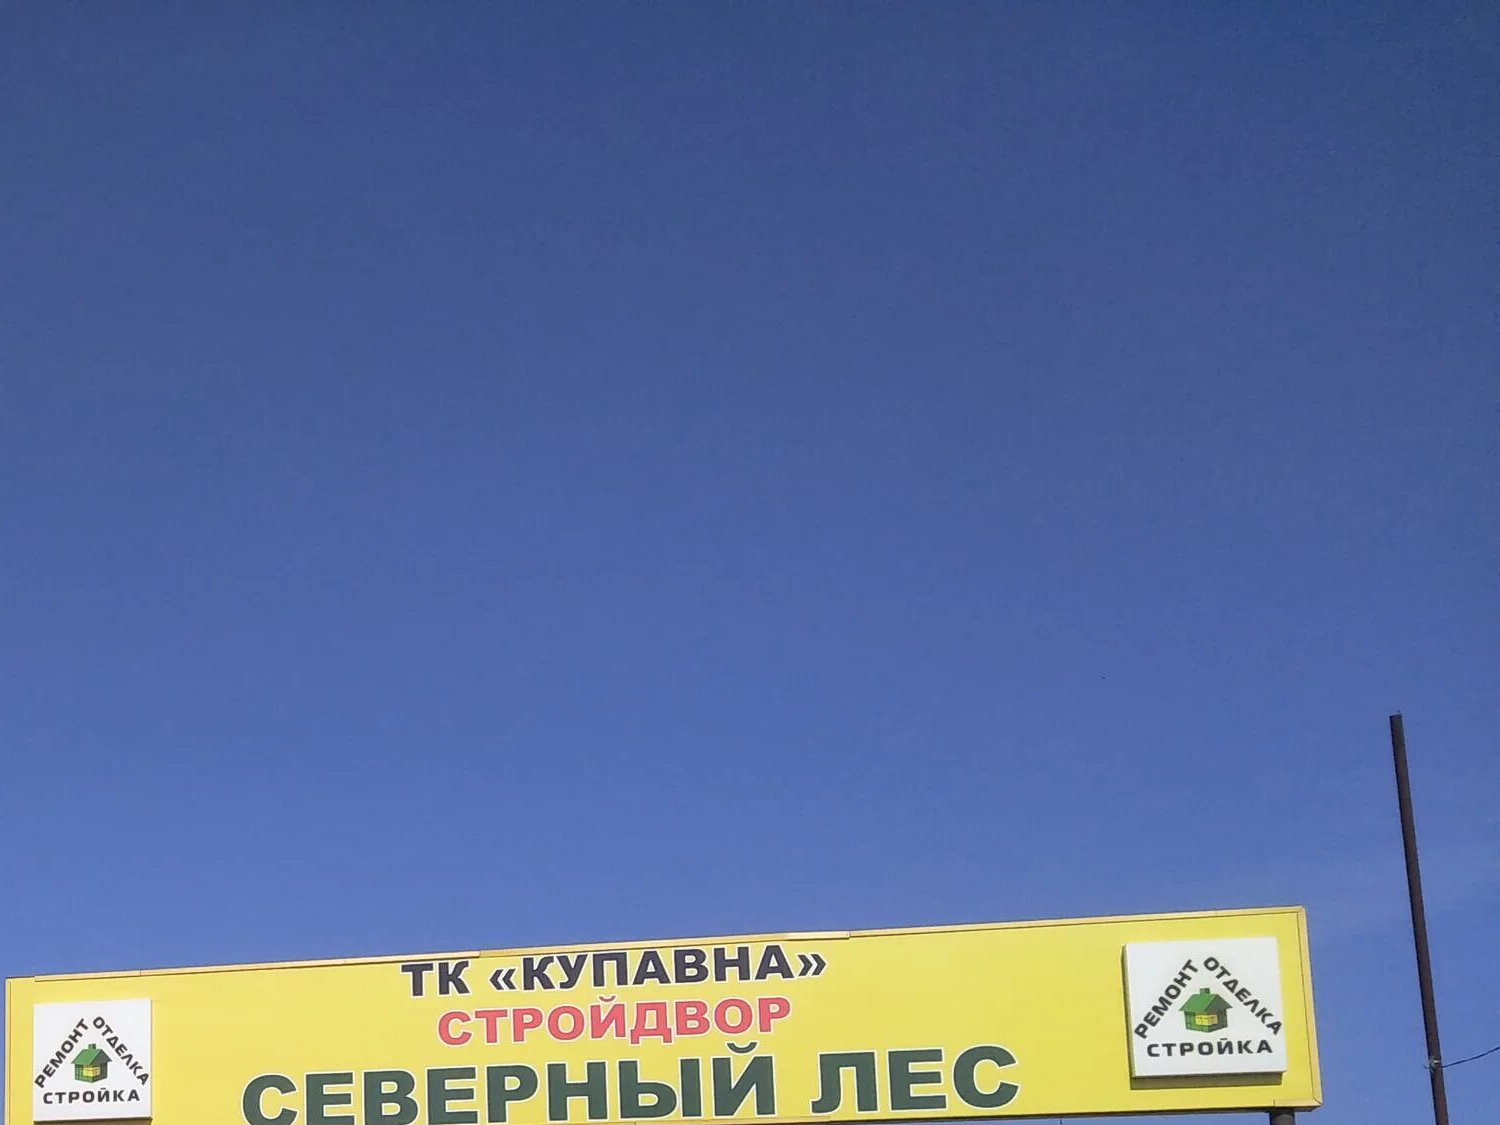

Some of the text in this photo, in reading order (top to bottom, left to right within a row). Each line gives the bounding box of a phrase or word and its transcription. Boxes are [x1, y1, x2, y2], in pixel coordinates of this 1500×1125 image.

[402, 945, 827, 998] ТК «КУПАВНА»
[1134, 959, 1198, 1039] РЕМОНТ
[1203, 956, 1282, 1035] ОТДЕЛКА
[34, 1018, 88, 1088] РЕМОНТ
[92, 1016, 149, 1085] ОТДЕЛКА
[436, 996, 792, 1046] СТРОЙДВОР
[1146, 1037, 1273, 1057] СТРОЙКА
[43, 1087, 140, 1104] СТРОЙКА
[810, 1045, 1020, 1114] ЛЕС
